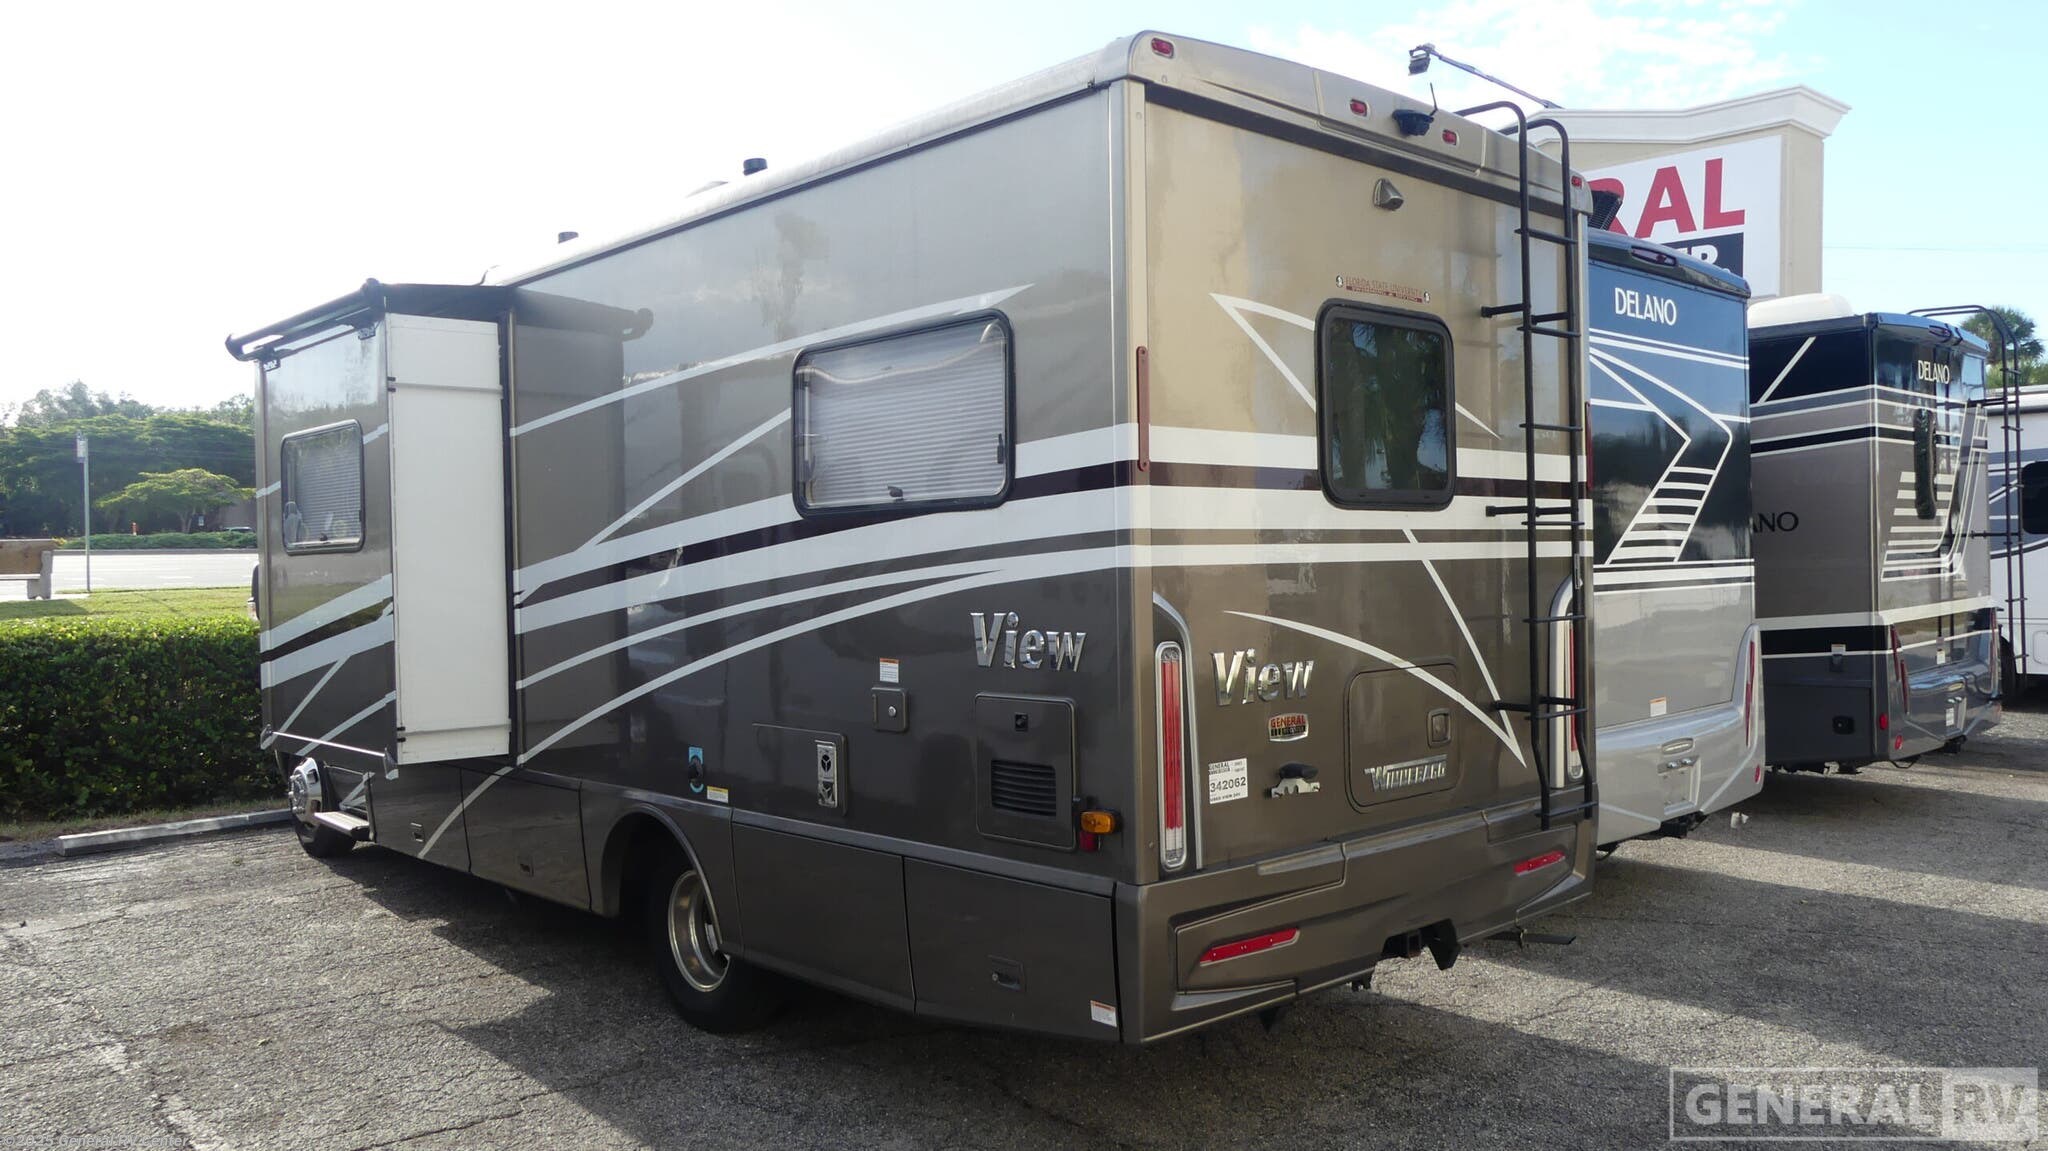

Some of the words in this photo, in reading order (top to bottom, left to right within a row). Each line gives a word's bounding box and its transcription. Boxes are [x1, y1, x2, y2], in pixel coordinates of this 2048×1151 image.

[1614, 287, 1677, 326] DELANO
[1917, 359, 1950, 385] DELANO
[970, 611, 1087, 673] View
[1212, 648, 1315, 707] View
[1270, 715, 1306, 728] GENERAL
[1210, 776, 1246, 792] 342062
